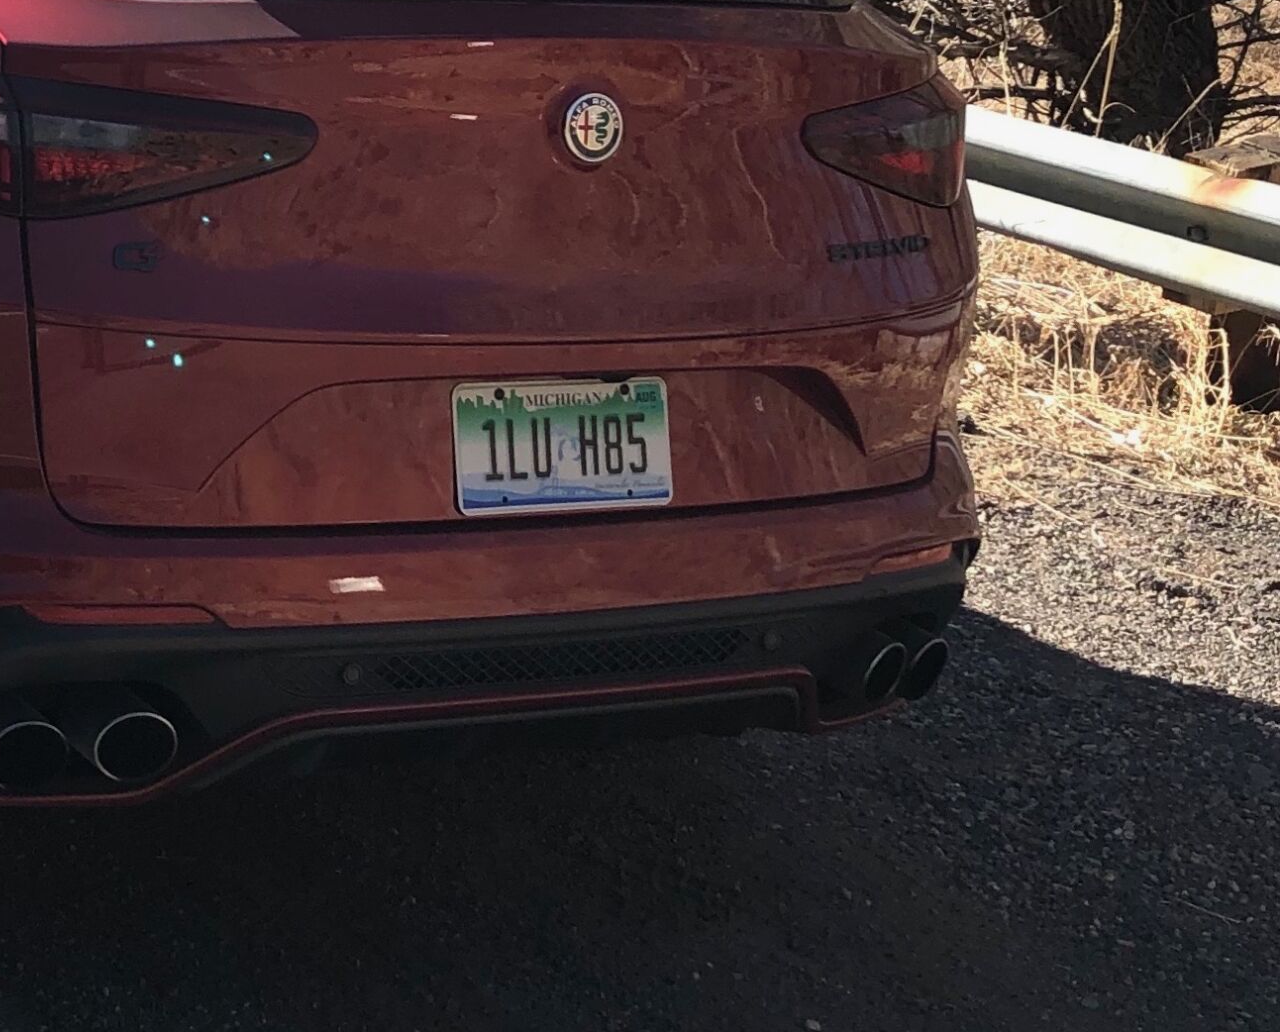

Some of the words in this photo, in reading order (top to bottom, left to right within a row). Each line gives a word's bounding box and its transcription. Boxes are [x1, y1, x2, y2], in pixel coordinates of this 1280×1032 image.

[570, 101, 589, 128] ALFA
[592, 97, 619, 129] ROMEO
[525, 391, 603, 408] MICHIGAN
[635, 390, 657, 404] AUG
[482, 417, 552, 482] 1LU
[578, 412, 648, 477] H85
